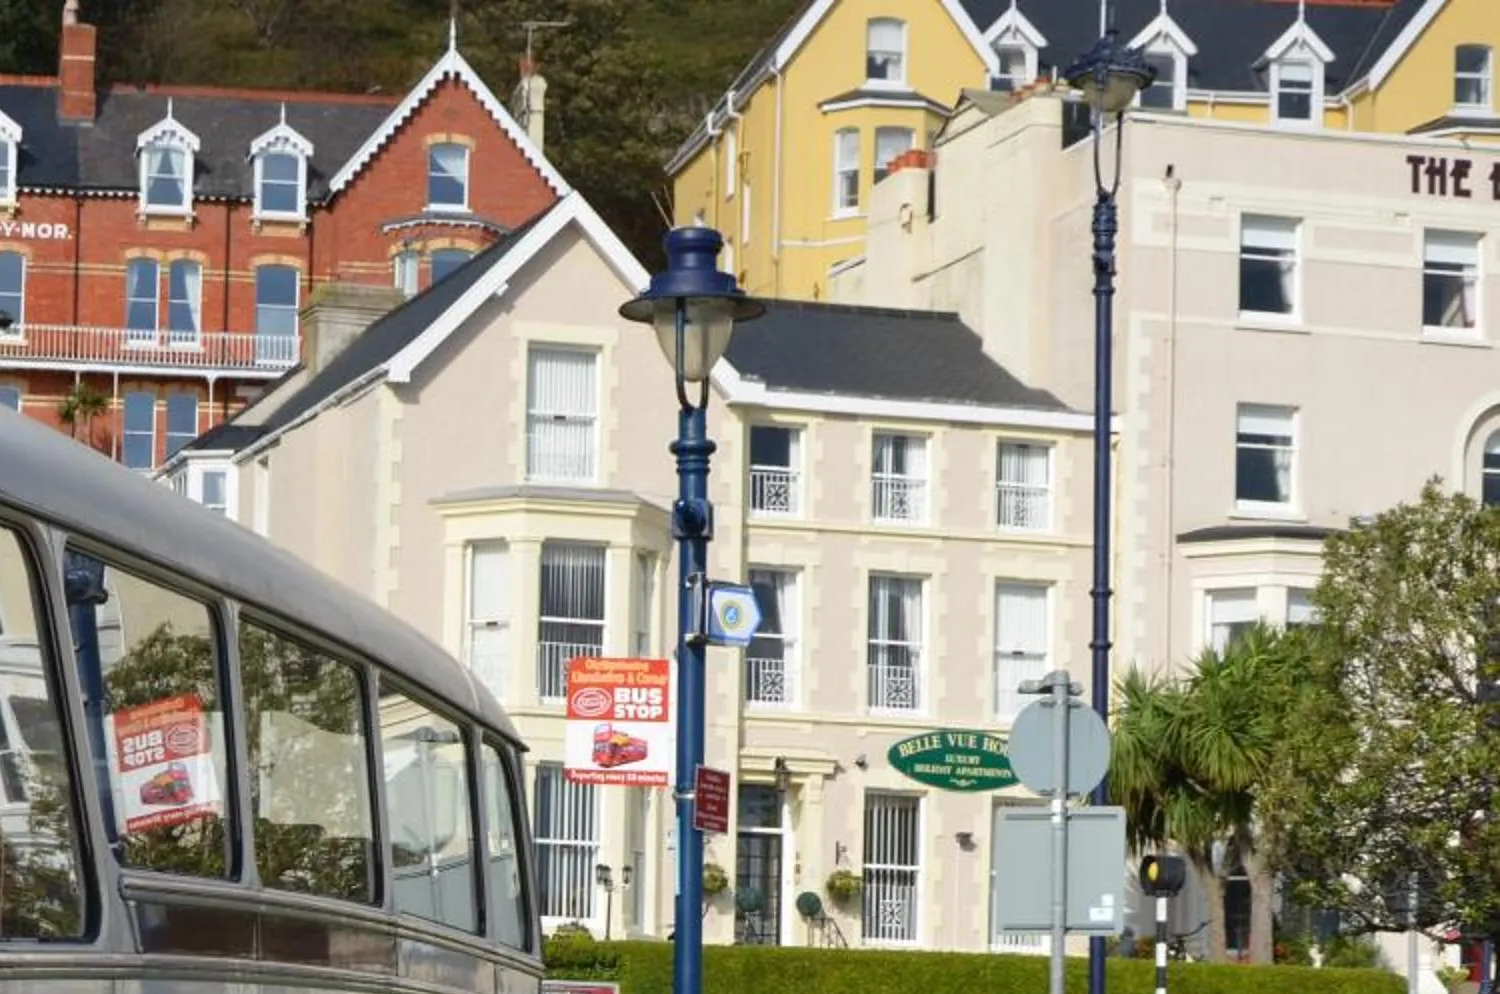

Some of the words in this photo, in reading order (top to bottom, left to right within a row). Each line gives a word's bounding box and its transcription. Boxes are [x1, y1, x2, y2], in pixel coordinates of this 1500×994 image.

[1406, 155, 1472, 198] THE
[613, 687, 663, 704] BUS
[613, 704, 664, 719] STOP
[898, 735, 942, 758] BELLE
[946, 733, 978, 748] VUE
